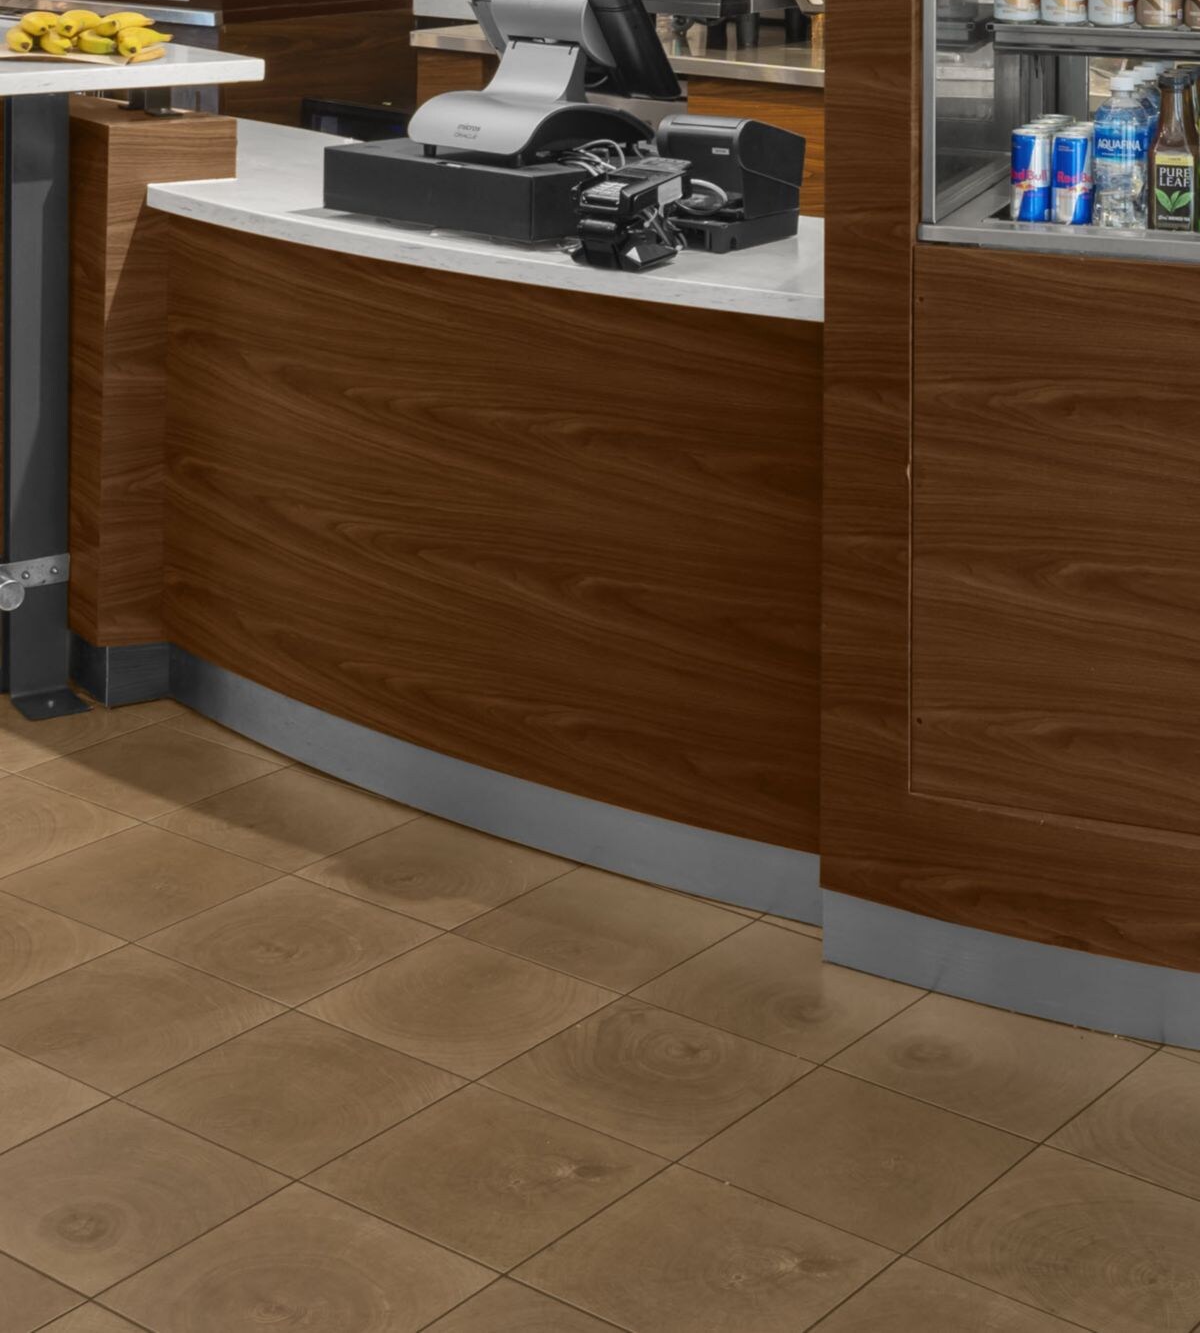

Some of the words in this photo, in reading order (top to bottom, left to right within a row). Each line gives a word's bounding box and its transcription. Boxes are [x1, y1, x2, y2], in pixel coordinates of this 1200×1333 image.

[1097, 138, 1142, 152] AQUAFINA
[1026, 169, 1048, 182] Bull
[1160, 167, 1190, 177] PURE
[1160, 177, 1190, 187] LEAF
